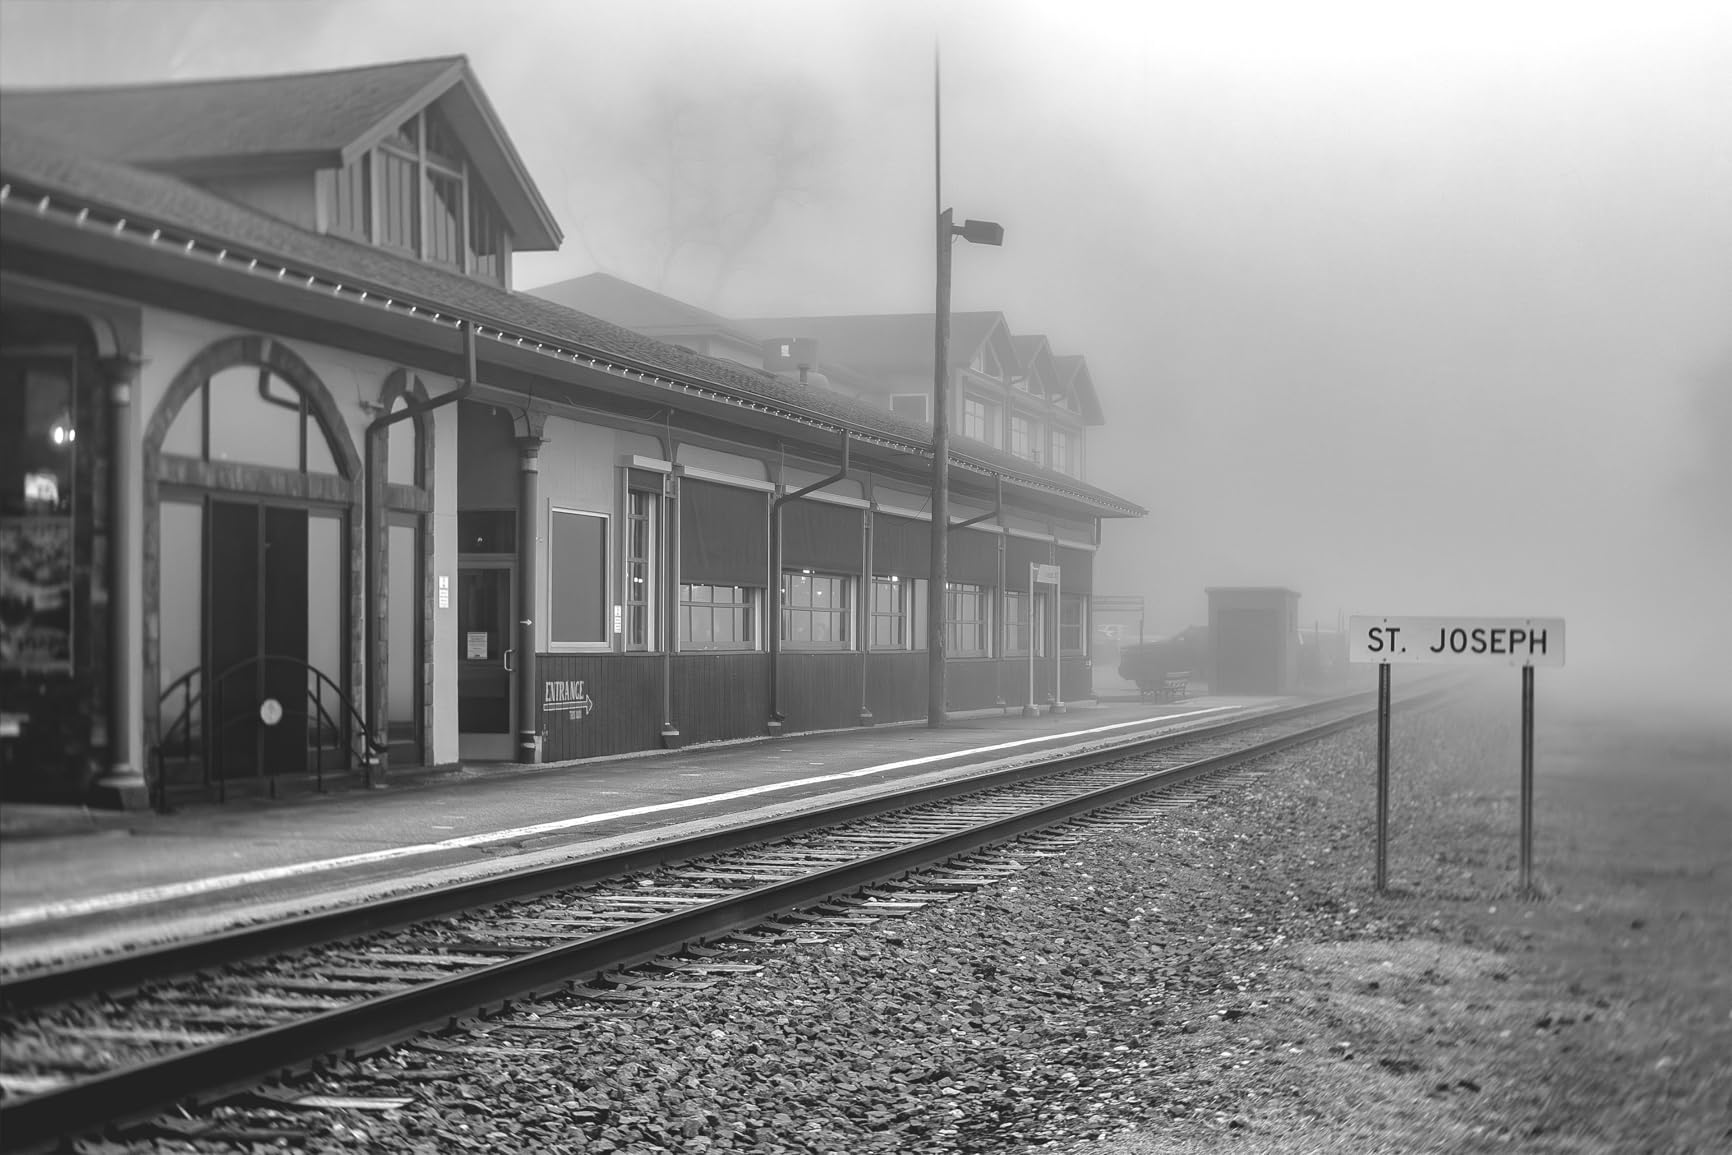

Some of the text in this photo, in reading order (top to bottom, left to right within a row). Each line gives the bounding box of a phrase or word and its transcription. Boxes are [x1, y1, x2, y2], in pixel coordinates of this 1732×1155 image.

[1367, 627, 1547, 655] ST. JOSEPH
[545, 680, 585, 702] ENTRANCE
